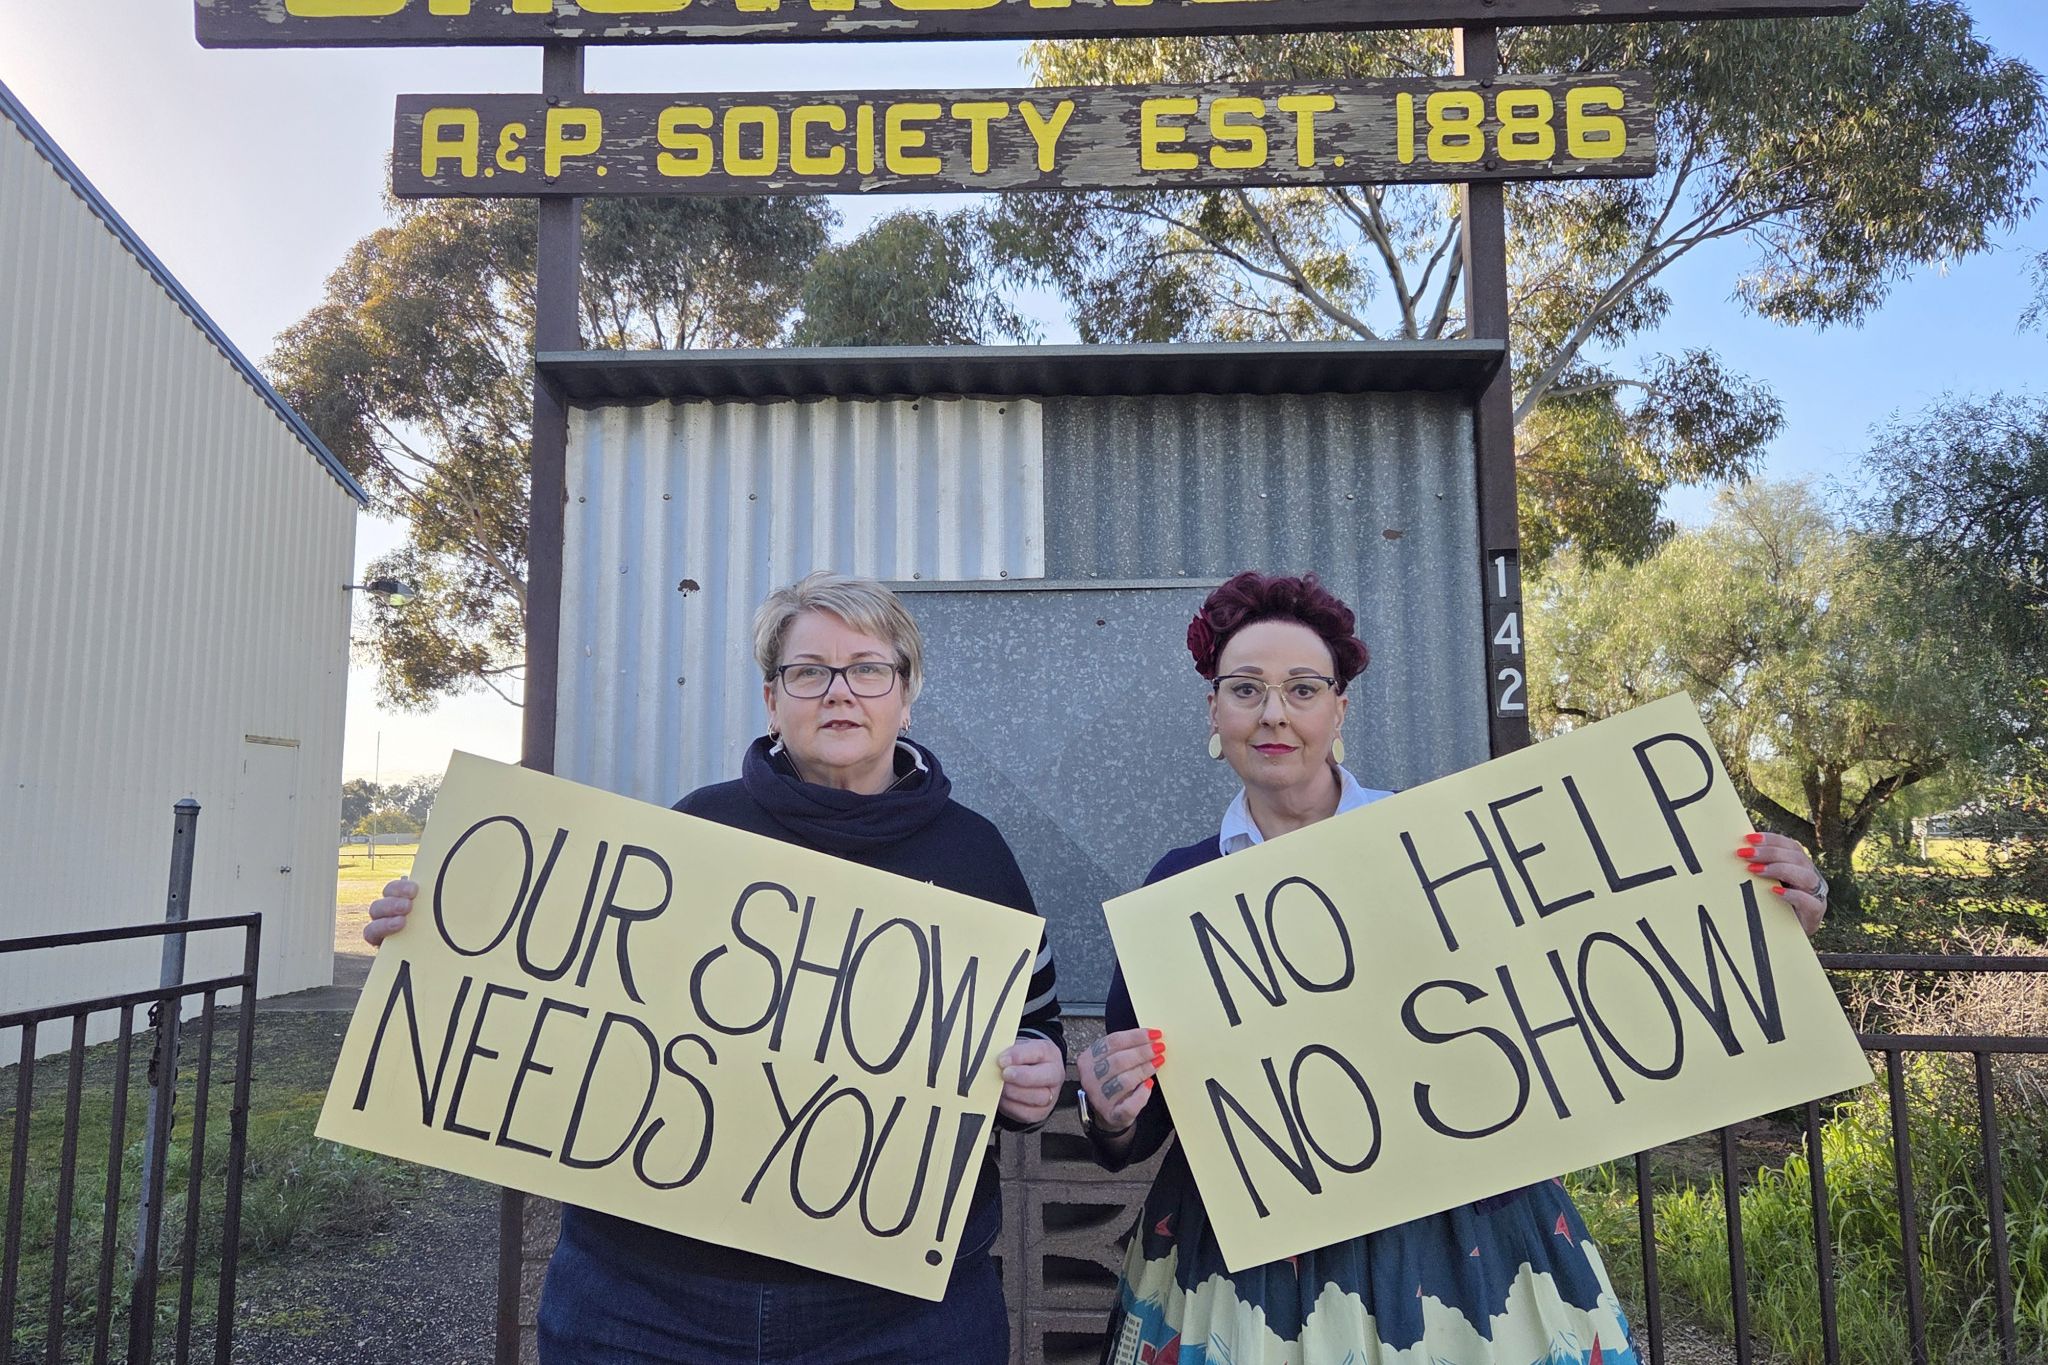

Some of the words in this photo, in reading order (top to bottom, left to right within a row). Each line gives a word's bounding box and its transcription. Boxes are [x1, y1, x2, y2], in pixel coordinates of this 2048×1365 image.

[657, 98, 1076, 176] SOCIETY
[1140, 94, 1346, 171] EST.
[1396, 85, 1627, 164] 1886
[432, 815, 673, 1006] OUR
[689, 881, 1031, 1098] SHOW
[1190, 876, 1355, 1027] NO
[1399, 732, 1714, 953] HELP
[353, 959, 718, 1190] NEEDS
[741, 1061, 987, 1267] YOU!
[1204, 1043, 1382, 1219] NO
[1400, 879, 1786, 1140] SHOW
